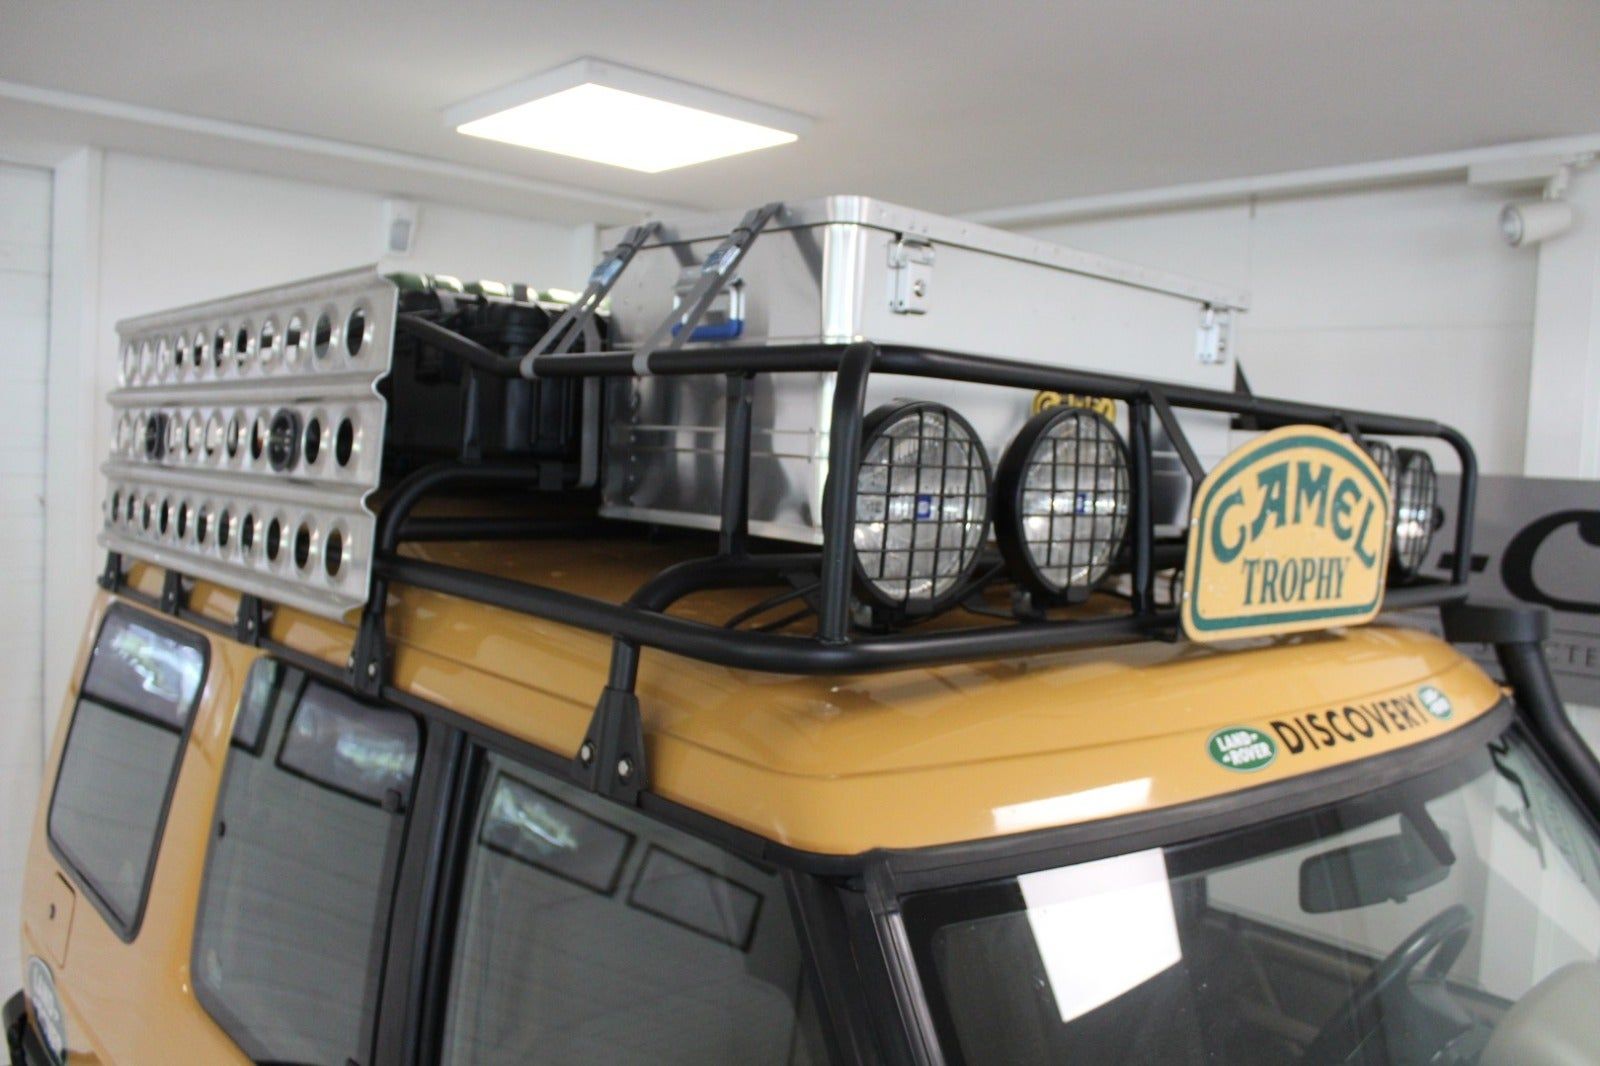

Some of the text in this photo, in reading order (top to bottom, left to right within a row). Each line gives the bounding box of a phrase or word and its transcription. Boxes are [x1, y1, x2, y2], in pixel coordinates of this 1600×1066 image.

[1211, 461, 1375, 569] CAMEL
[1242, 556, 1350, 606] TROPHY
[1269, 692, 1428, 754] DISCOVERY
